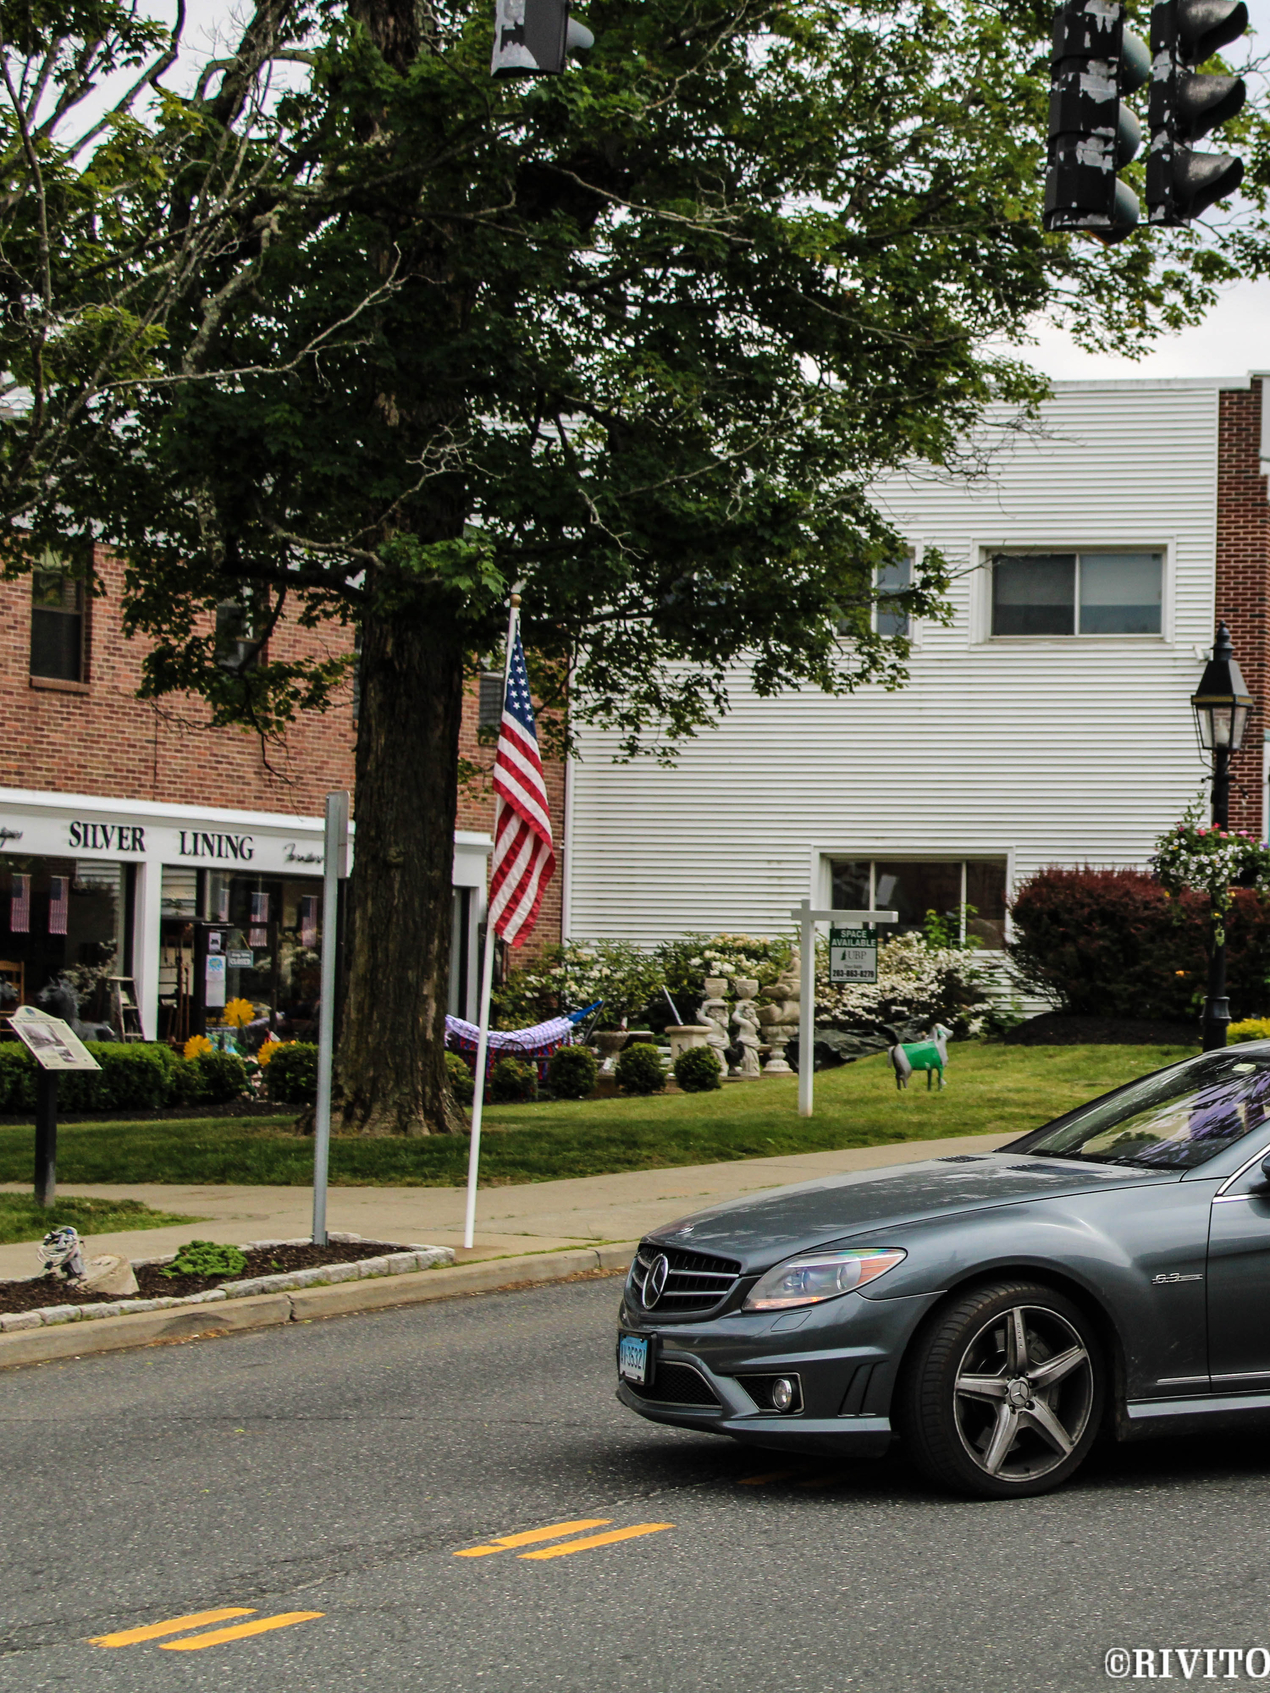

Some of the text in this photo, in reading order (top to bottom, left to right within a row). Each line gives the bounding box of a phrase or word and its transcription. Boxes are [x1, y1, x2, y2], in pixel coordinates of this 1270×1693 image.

[69, 821, 254, 861] SILVER LINING
[841, 930, 868, 938] SPACE
[831, 938, 877, 947] AVAILABLE
[847, 950, 867, 960] UBP
